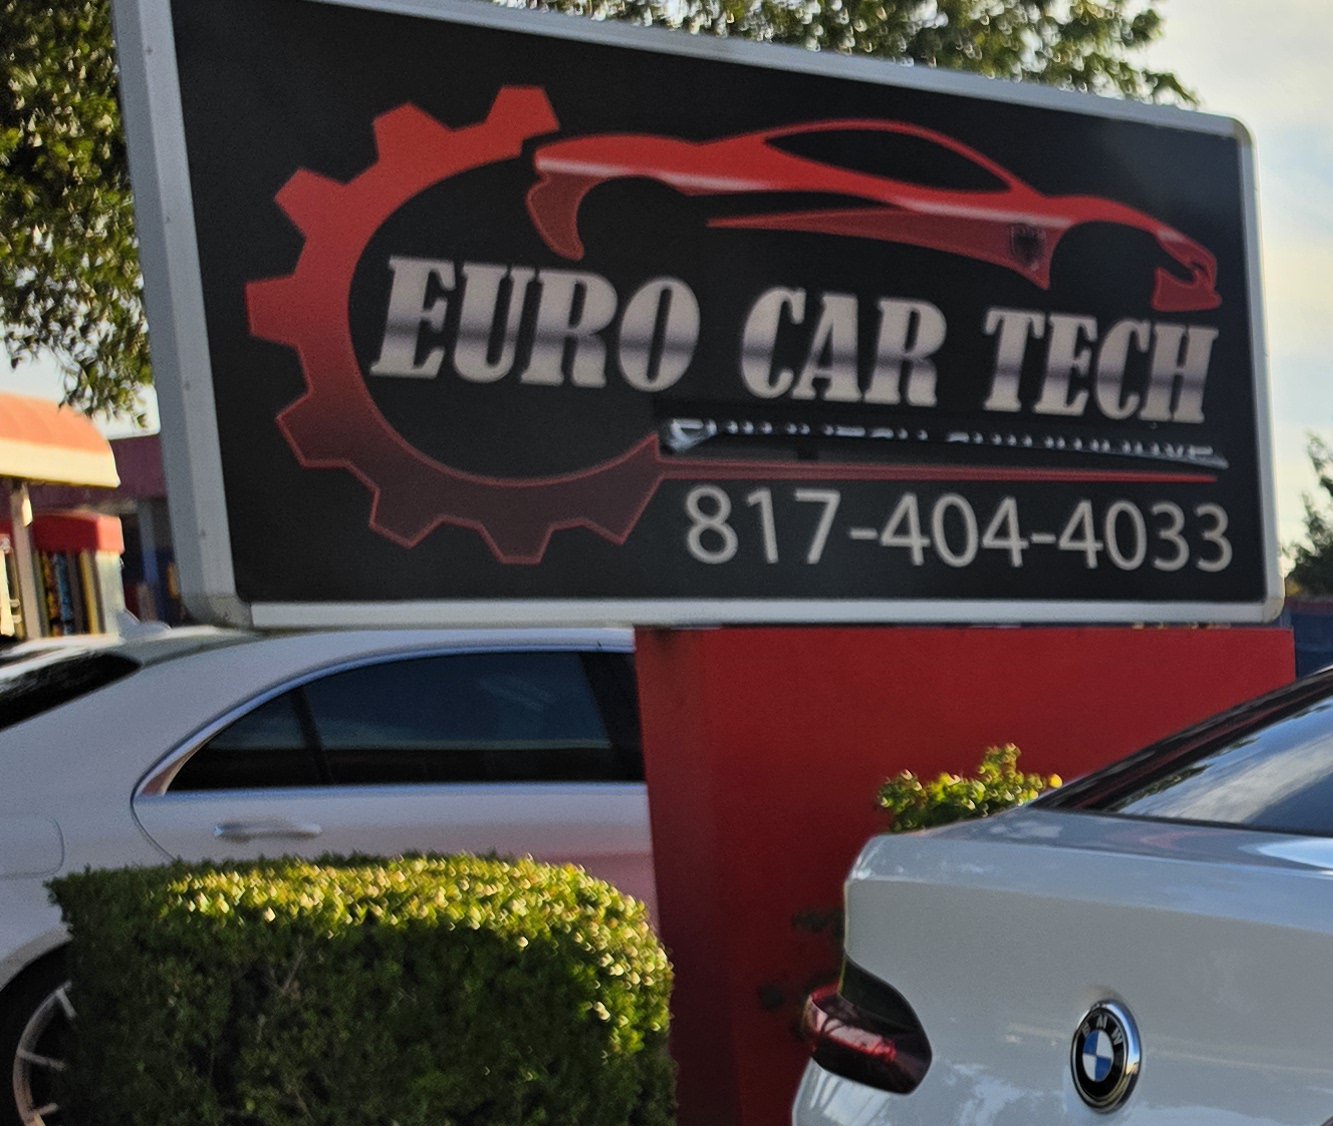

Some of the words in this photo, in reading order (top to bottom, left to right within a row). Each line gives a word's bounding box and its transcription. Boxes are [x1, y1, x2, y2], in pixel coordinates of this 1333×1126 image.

[370, 254, 700, 392] EURO
[739, 285, 947, 408] CAR
[983, 308, 1219, 423] TECH
[683, 485, 1233, 571] 817-404-4033
